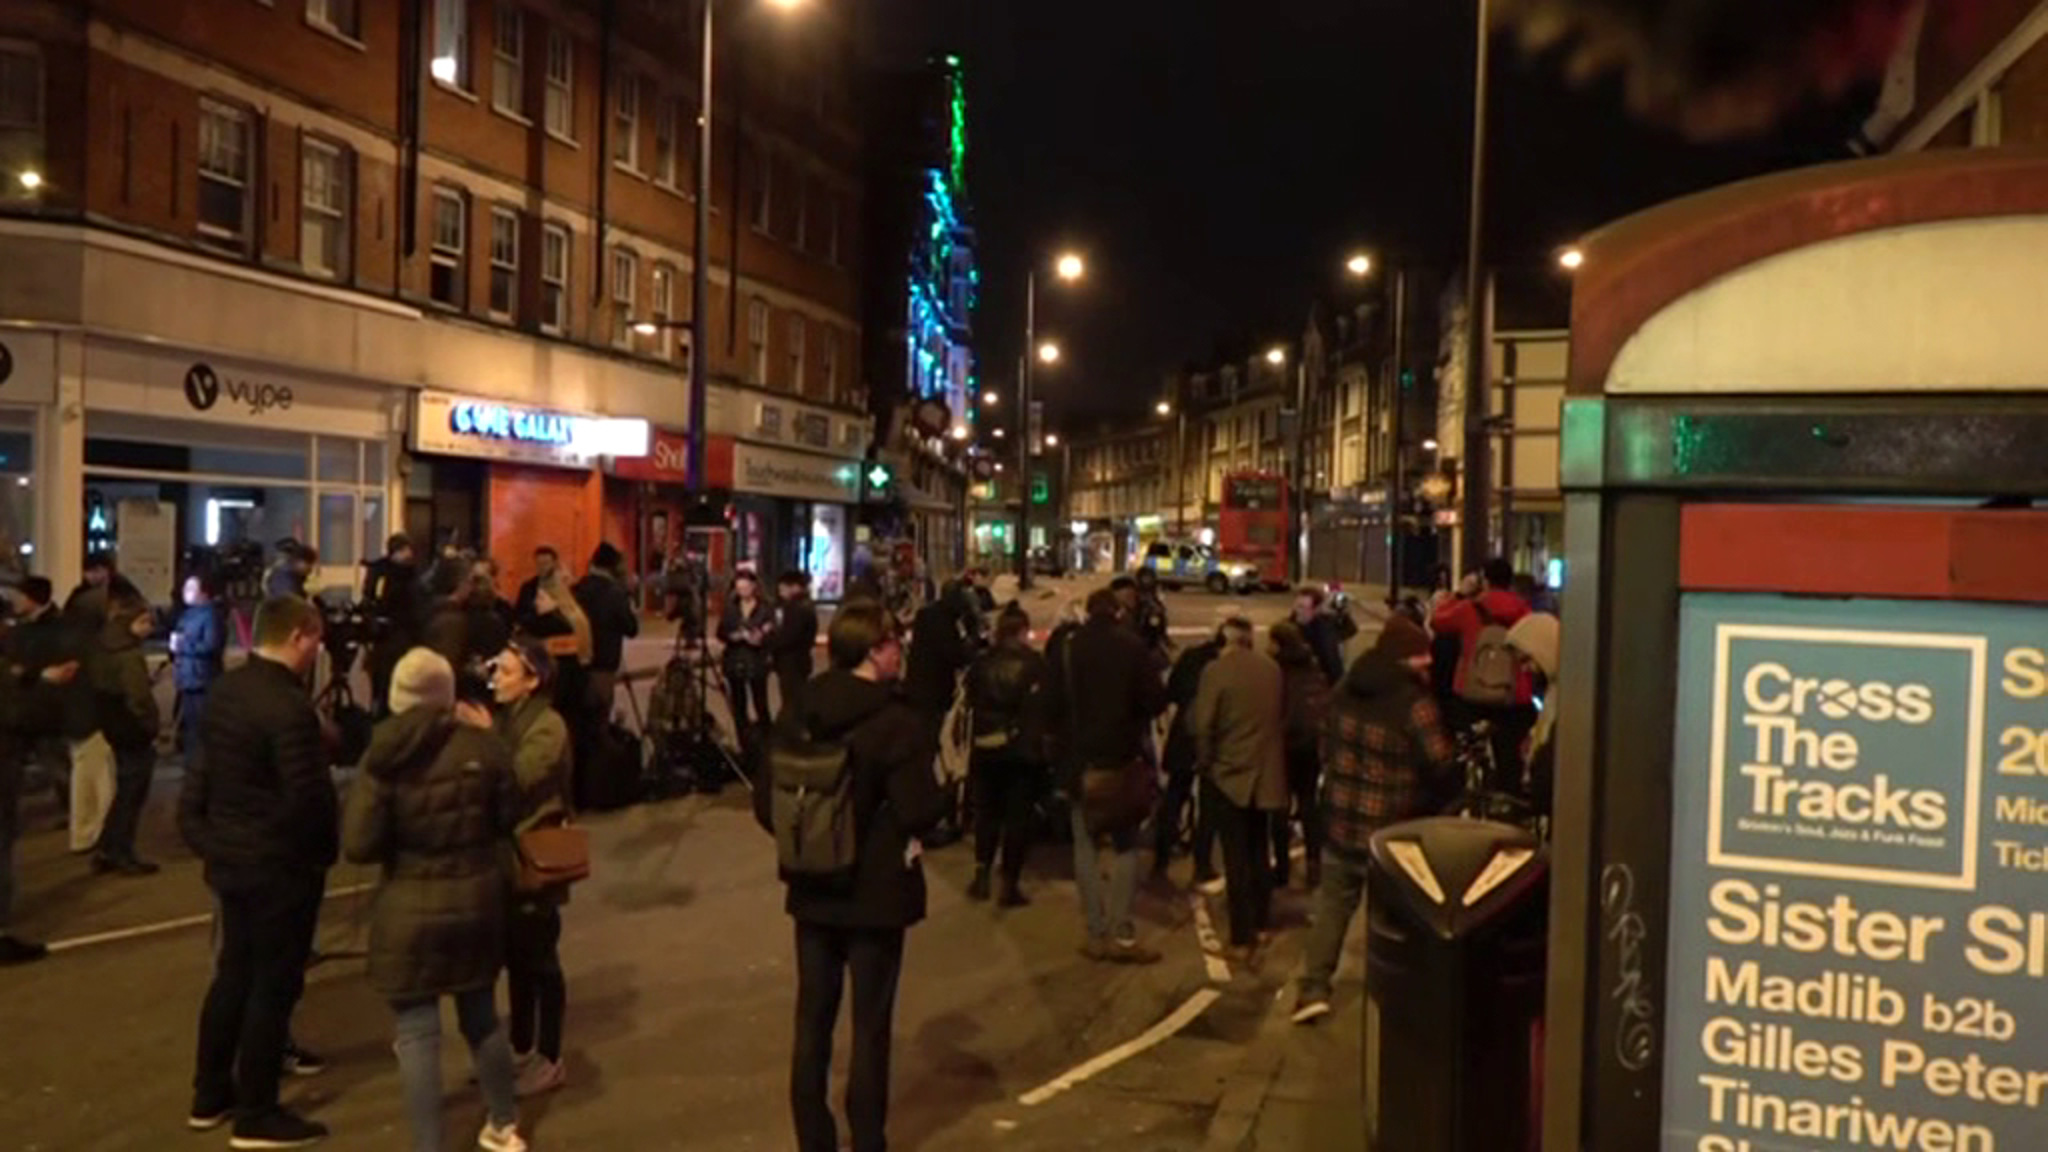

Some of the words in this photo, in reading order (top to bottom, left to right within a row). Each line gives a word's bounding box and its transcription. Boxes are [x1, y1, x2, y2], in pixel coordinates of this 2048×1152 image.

[225, 377, 293, 415] vype
[1743, 661, 1933, 724] Cross
[1743, 713, 1859, 771] The
[1739, 764, 1947, 830] Tracks
[1706, 878, 1945, 962] Sister
[1704, 956, 1906, 1026] Madlib
[1922, 993, 2017, 1041] b2b
[1701, 1016, 1863, 1082] Gilles
[1881, 1039, 2048, 1107] Peter
[1698, 1074, 1995, 1152] Tinariwen
